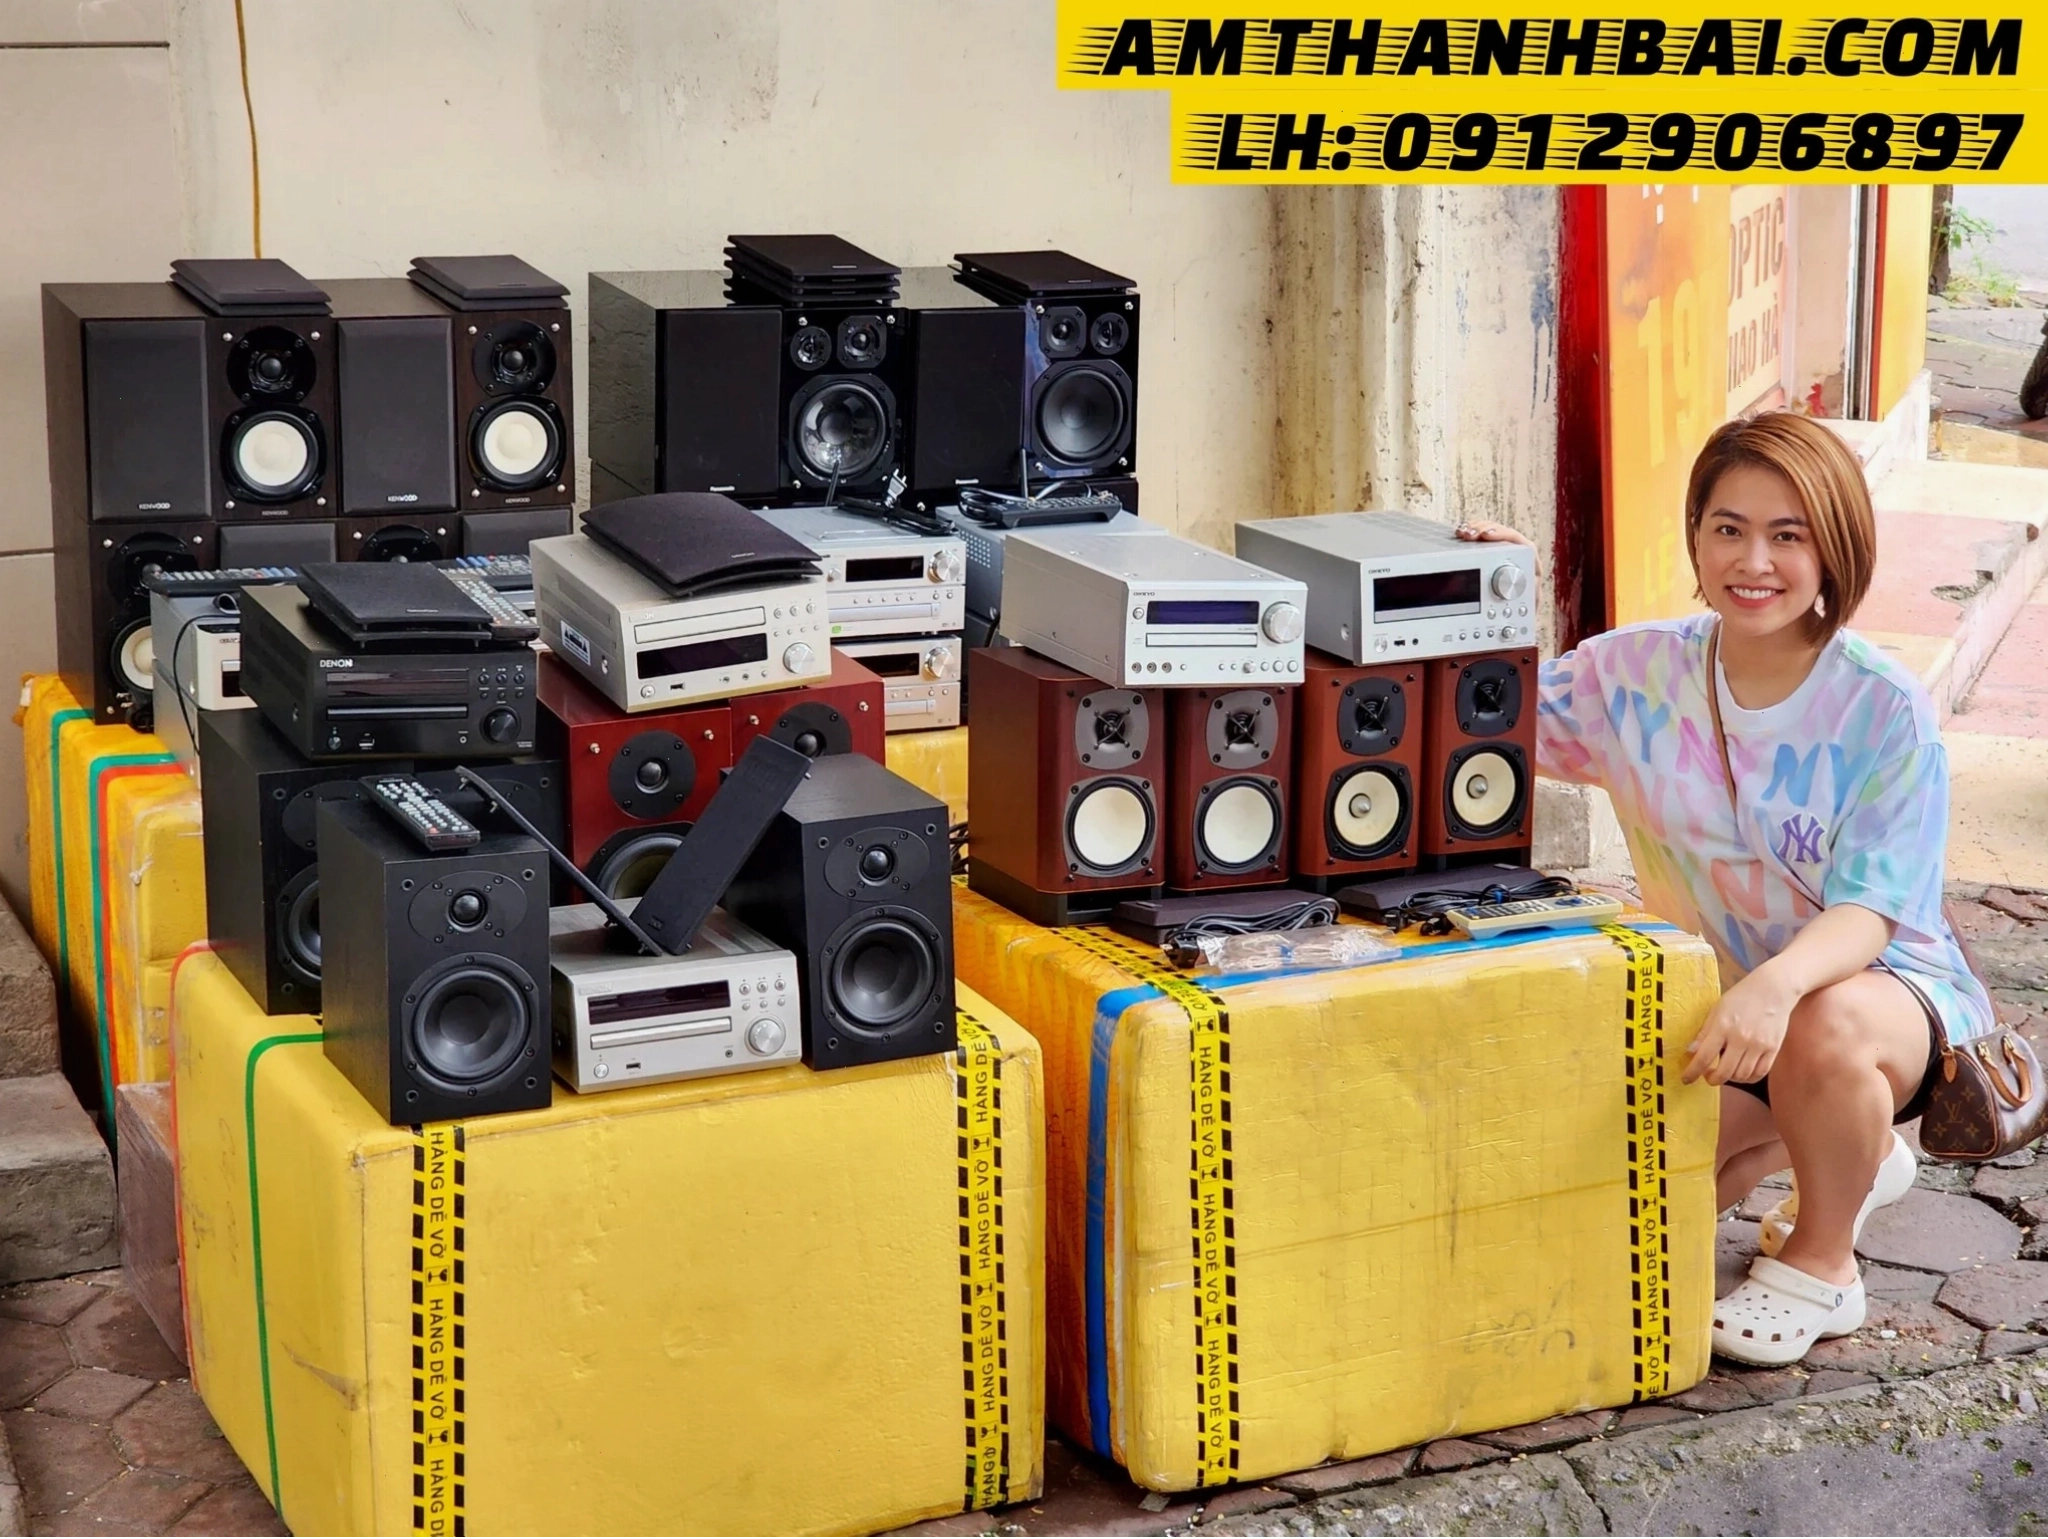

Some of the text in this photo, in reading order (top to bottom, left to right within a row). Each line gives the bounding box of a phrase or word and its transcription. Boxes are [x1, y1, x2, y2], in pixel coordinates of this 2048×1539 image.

[139, 502, 171, 511] KENWOOD
[319, 658, 354, 669] DENON
[430, 1132, 448, 1190] HÀNG
[429, 1299, 447, 1354] HÀNG
[430, 1459, 448, 1514] HÀNG
